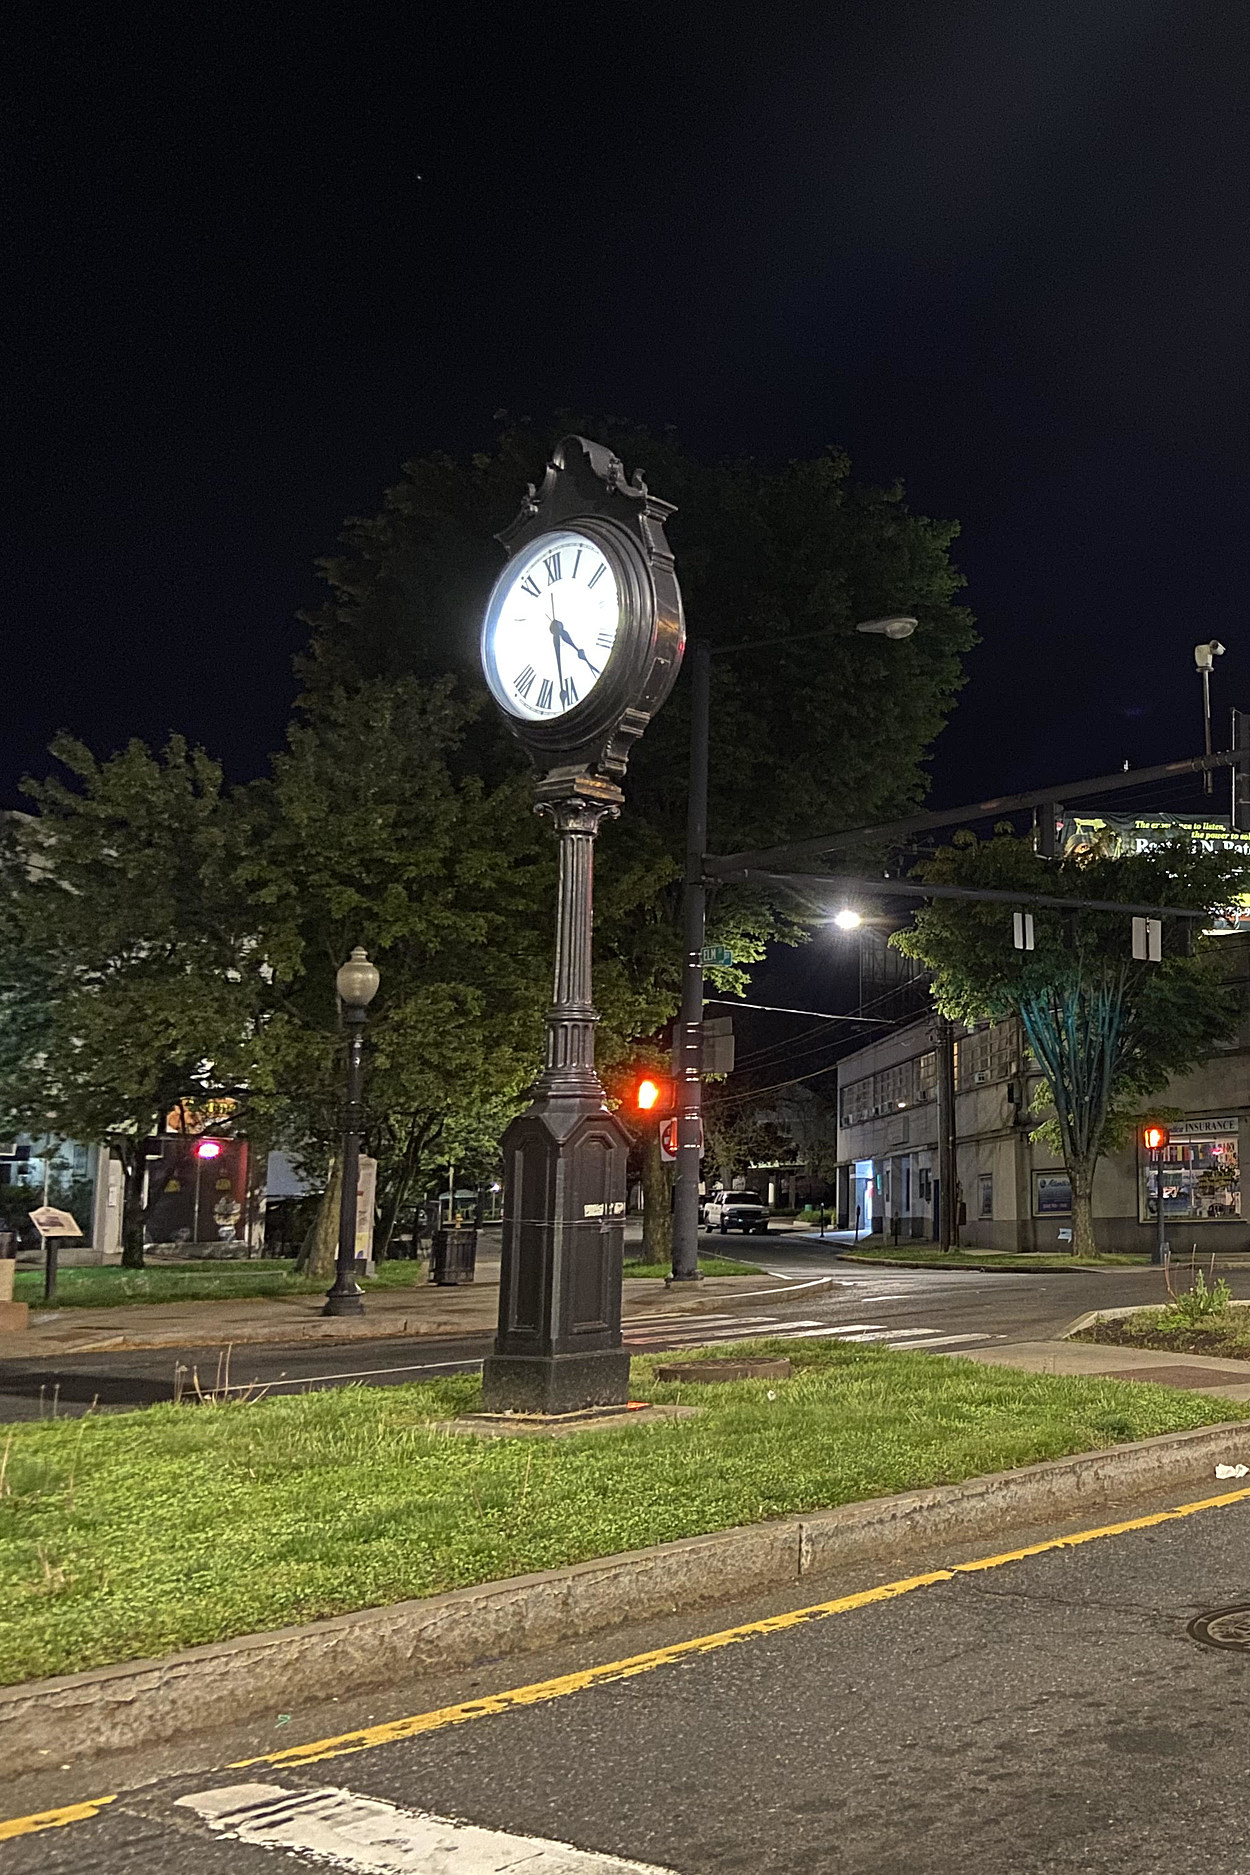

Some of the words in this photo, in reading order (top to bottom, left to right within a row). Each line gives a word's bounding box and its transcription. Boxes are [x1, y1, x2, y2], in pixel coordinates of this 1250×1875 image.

[543, 551, 563, 587] XII
[1135, 820, 1150, 829] The
[1191, 831, 1205, 839] the
[1185, 1120, 1236, 1132] INSURANCE
